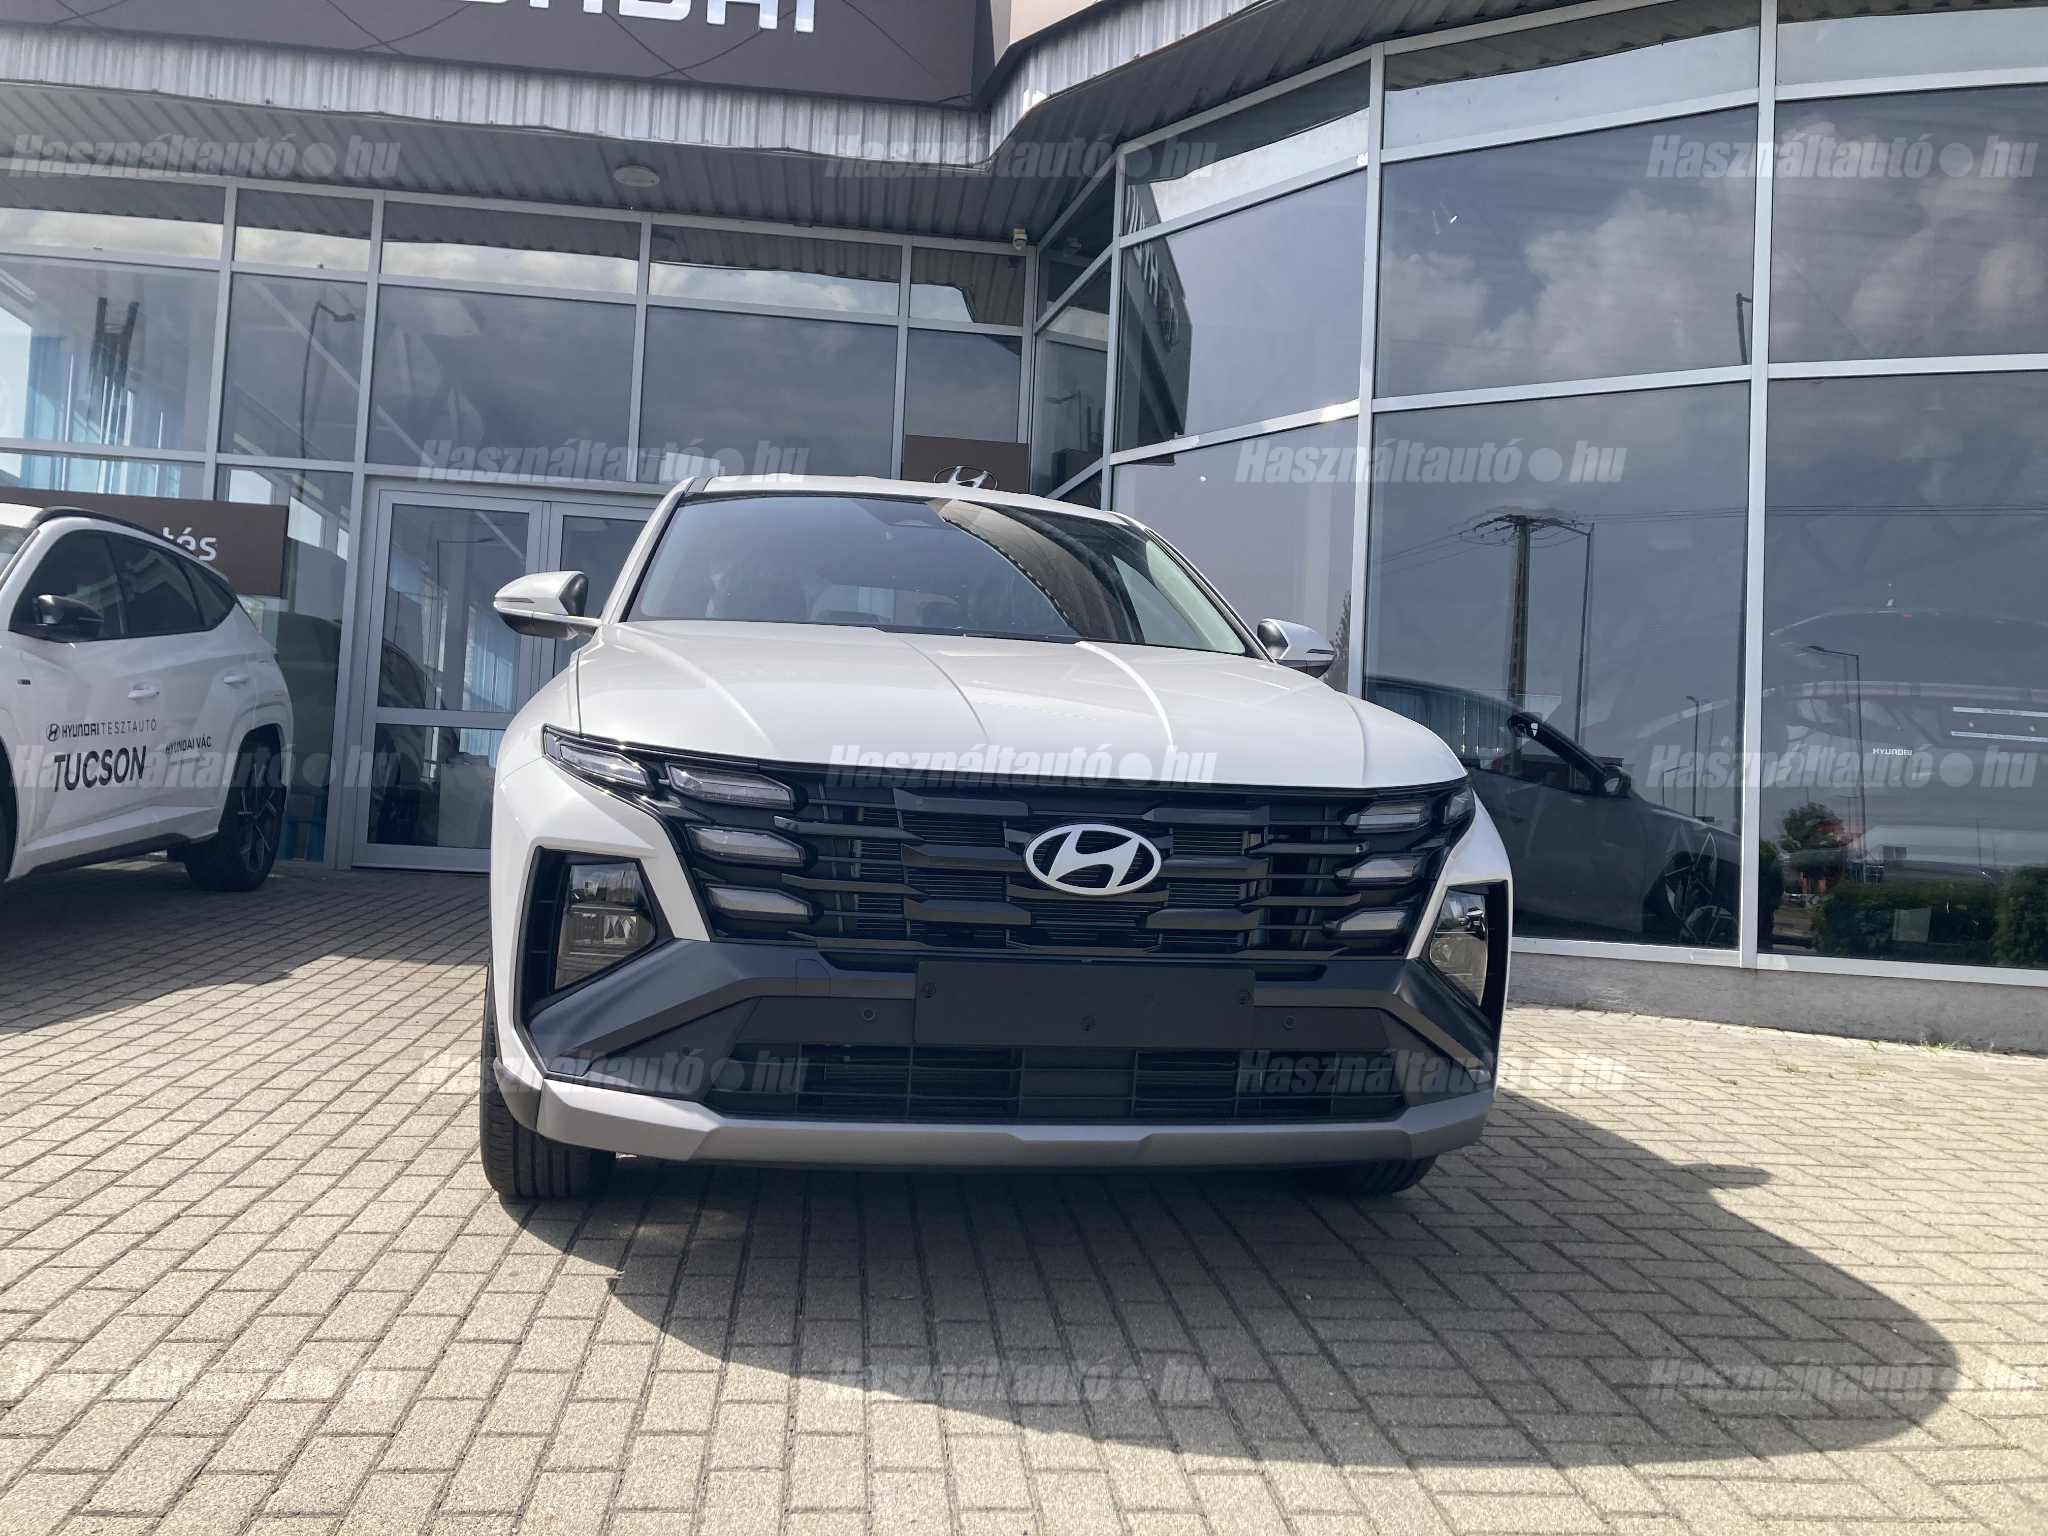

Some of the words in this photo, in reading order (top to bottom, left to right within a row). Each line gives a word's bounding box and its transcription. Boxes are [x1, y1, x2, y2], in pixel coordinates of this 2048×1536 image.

[62, 722, 99, 738] HYUNDAI
[101, 719, 157, 735] TESZTAUTÓ
[165, 738, 195, 755] HYUNDAI
[196, 735, 212, 750] VÁC
[54, 745, 147, 792] TUCSON
